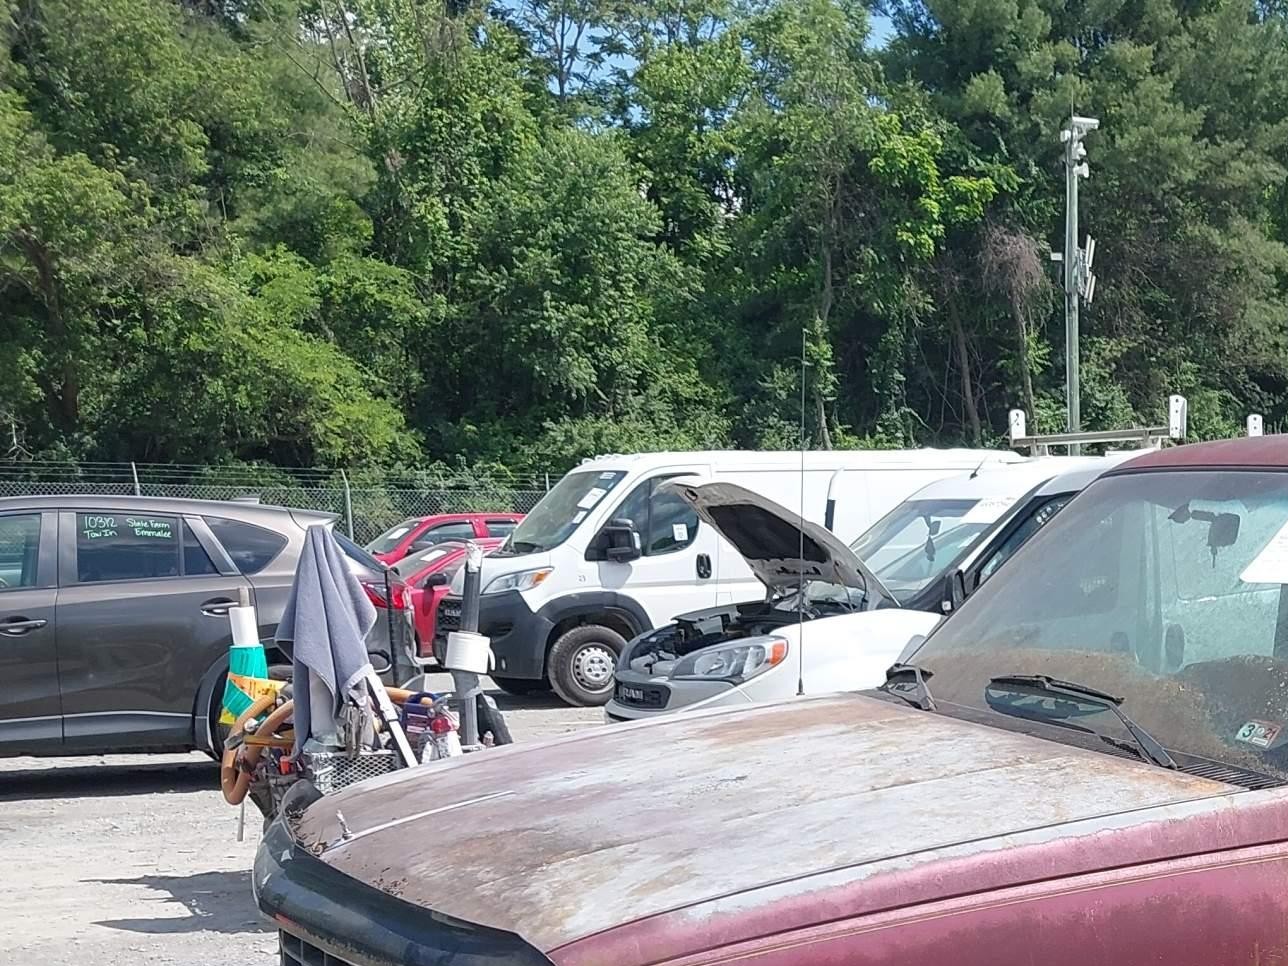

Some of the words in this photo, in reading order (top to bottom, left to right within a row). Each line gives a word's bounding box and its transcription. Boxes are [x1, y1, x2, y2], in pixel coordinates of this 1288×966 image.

[126, 517, 149, 528] State
[150, 518, 170, 529] Farm
[83, 529, 102, 540] Tow
[103, 529, 118, 537] In
[134, 527, 172, 538] Emmalee
[1242, 724, 1256, 738] 3
